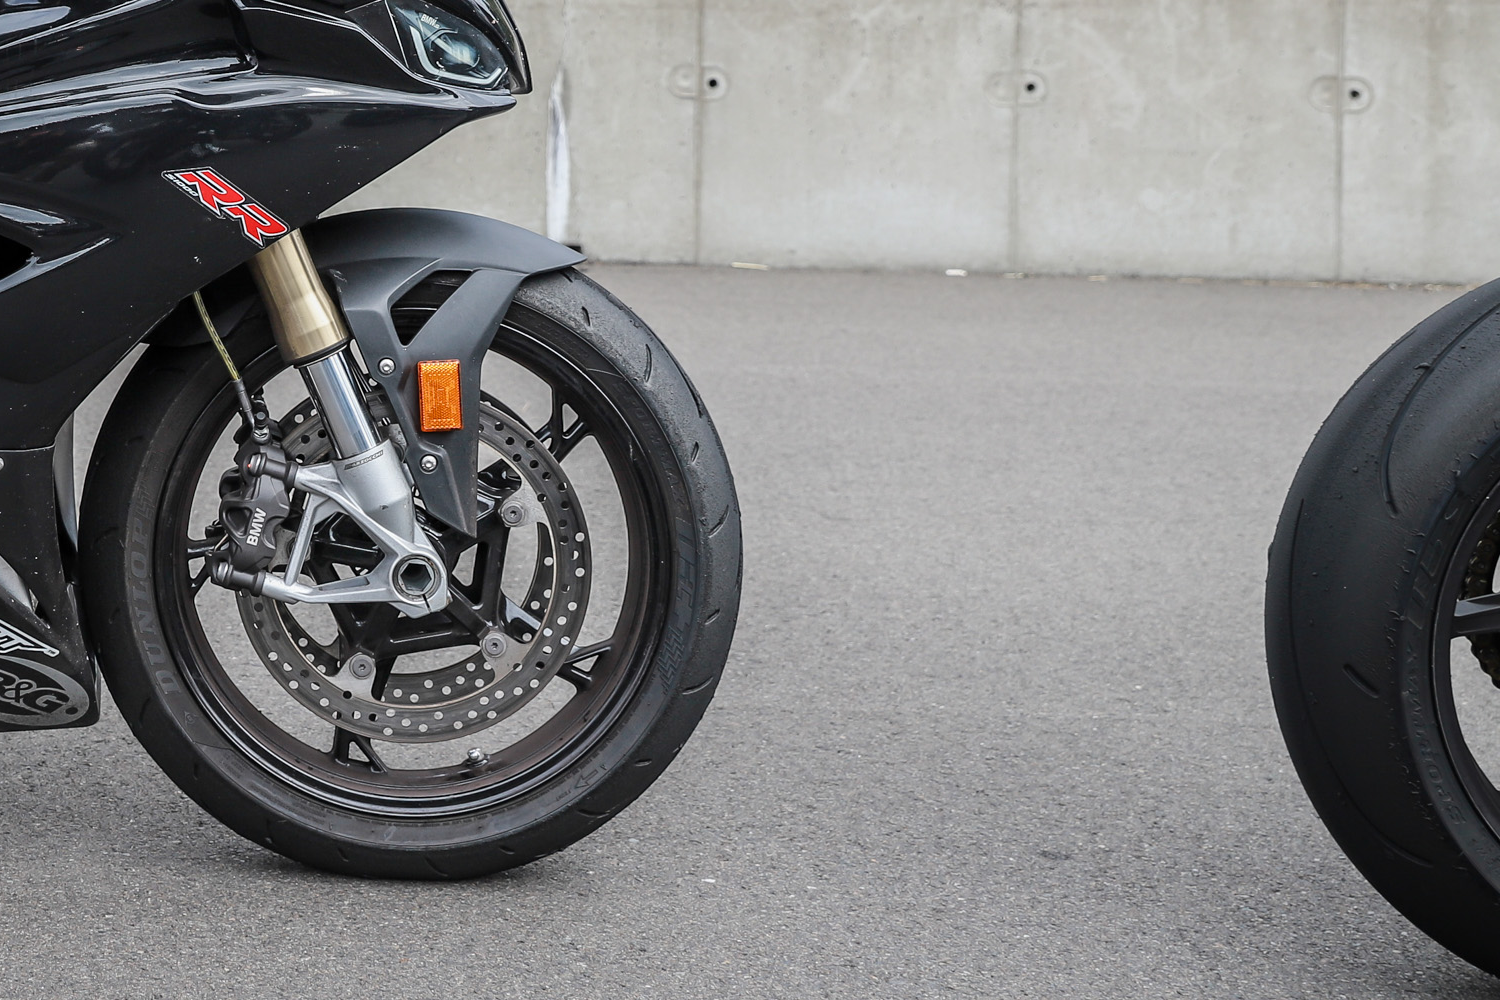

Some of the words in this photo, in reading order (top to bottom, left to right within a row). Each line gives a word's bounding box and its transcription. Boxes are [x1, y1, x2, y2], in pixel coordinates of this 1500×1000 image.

[174, 168, 290, 248] RR
[246, 507, 267, 547] BMW
[131, 517, 184, 697] DUNLOP
